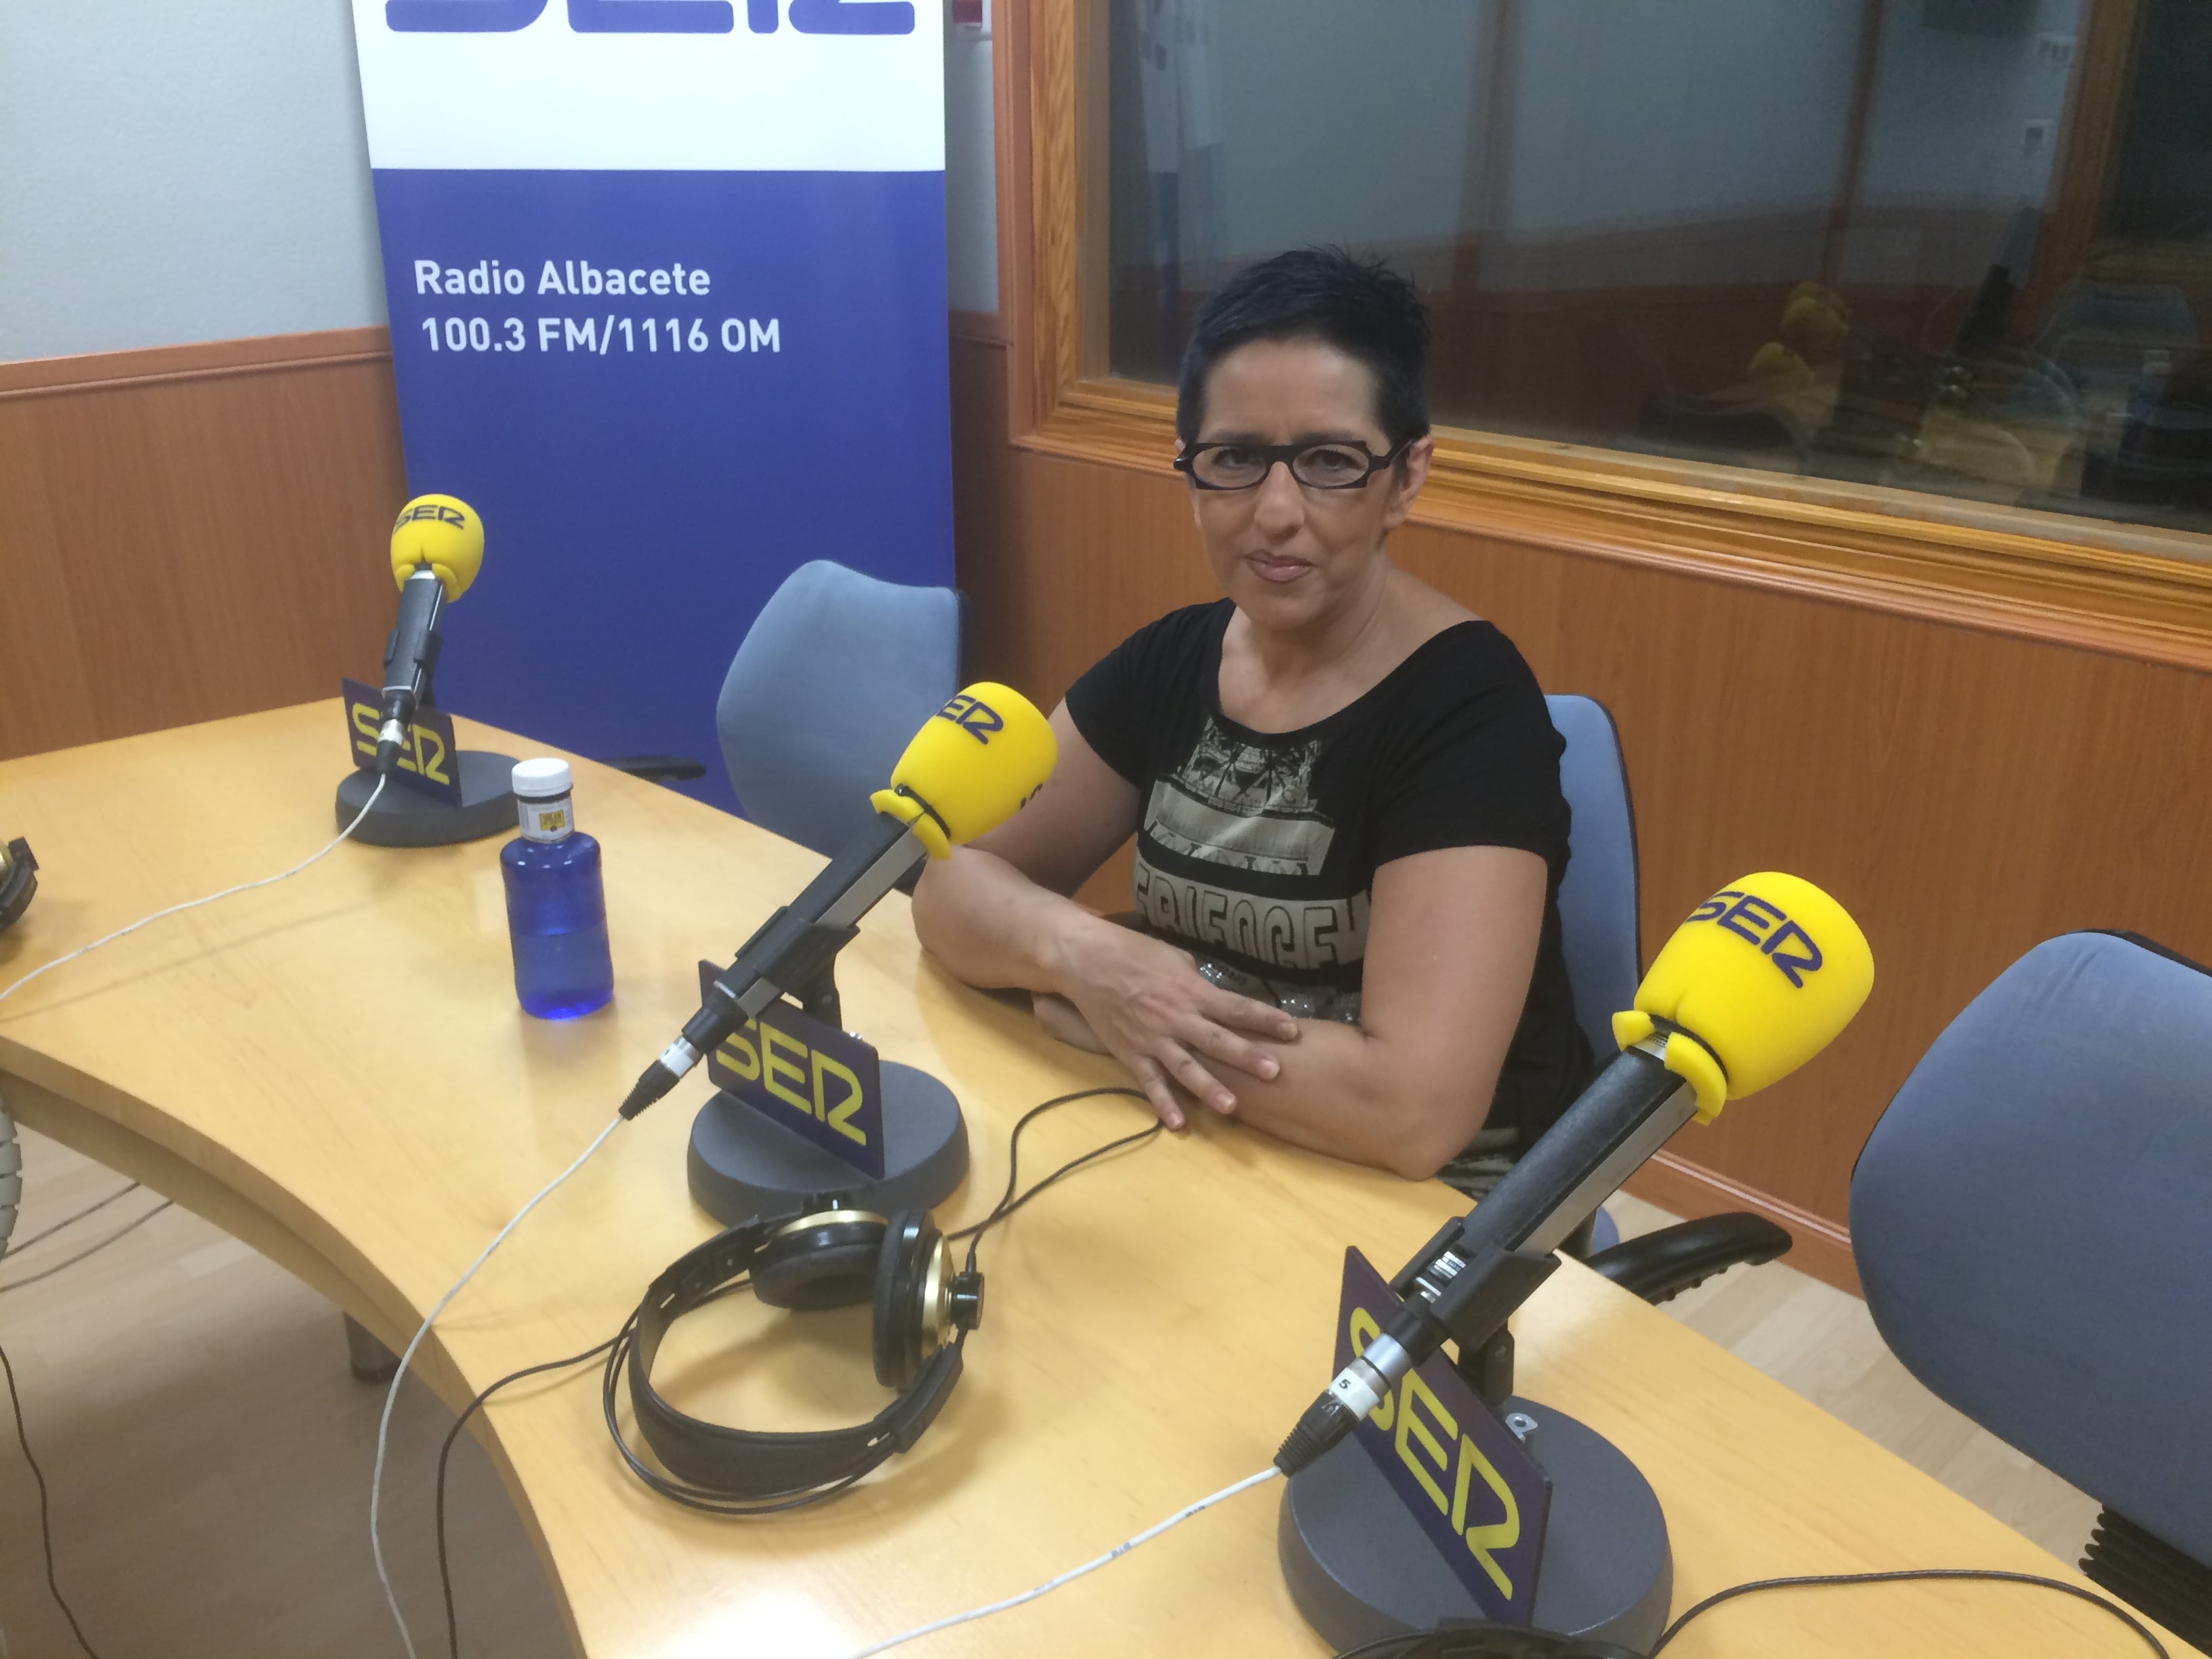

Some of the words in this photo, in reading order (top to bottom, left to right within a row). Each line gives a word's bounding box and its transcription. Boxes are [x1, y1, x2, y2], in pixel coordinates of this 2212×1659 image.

[414, 260, 525, 295] Radio
[537, 260, 711, 295] Albacete
[422, 317, 526, 352] 100.3
[538, 314, 709, 355] FM/1116
[721, 319, 780, 352] OM
[394, 505, 465, 534] SER
[1684, 891, 1823, 989] SER
[1339, 1378, 1351, 1389] 5
